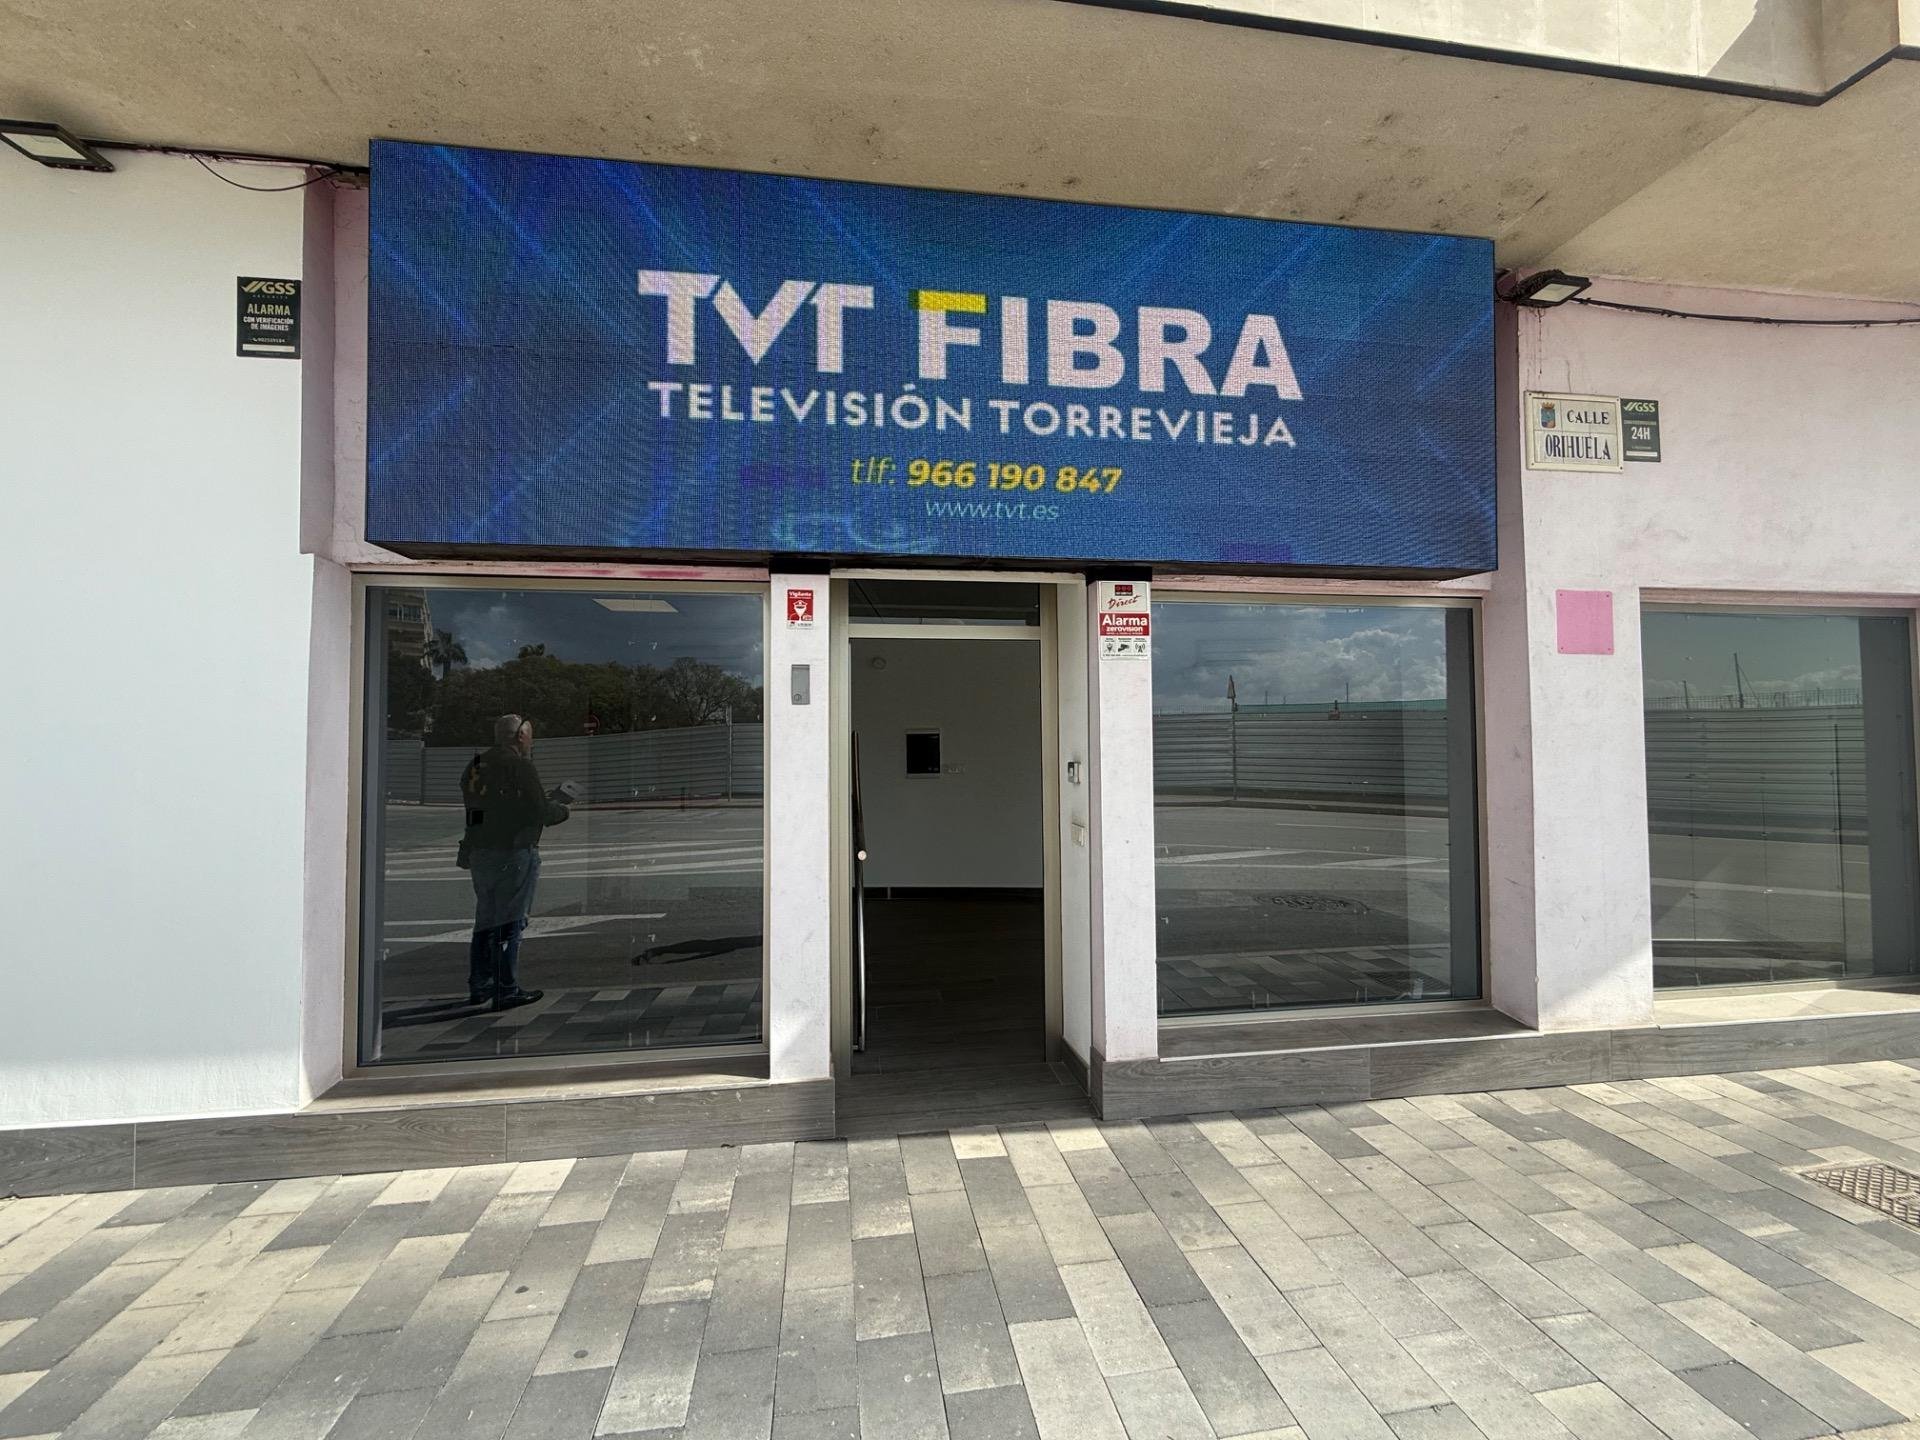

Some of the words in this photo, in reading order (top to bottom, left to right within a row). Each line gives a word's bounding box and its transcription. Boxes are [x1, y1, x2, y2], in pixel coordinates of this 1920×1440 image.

[261, 282, 295, 295] GSS
[247, 303, 291, 315] ALARMA
[637, 269, 875, 374] TVT
[916, 289, 1303, 402] FIBRA
[1635, 402, 1656, 412] GSS
[648, 381, 972, 432] TELEVISIÓN
[988, 400, 1296, 448] TORREVIEJA
[1567, 409, 1610, 424] CALLE
[1631, 426, 1651, 440] 24H
[1545, 434, 1612, 460] ORIHUELA
[851, 456, 897, 485] tlf:
[907, 458, 977, 489] 966
[987, 461, 1047, 491] 190
[1055, 465, 1123, 494] 847
[925, 500, 1061, 520] www.tvt.es
[1108, 595, 1142, 609] Direct
[1102, 614, 1148, 625] Alarma
